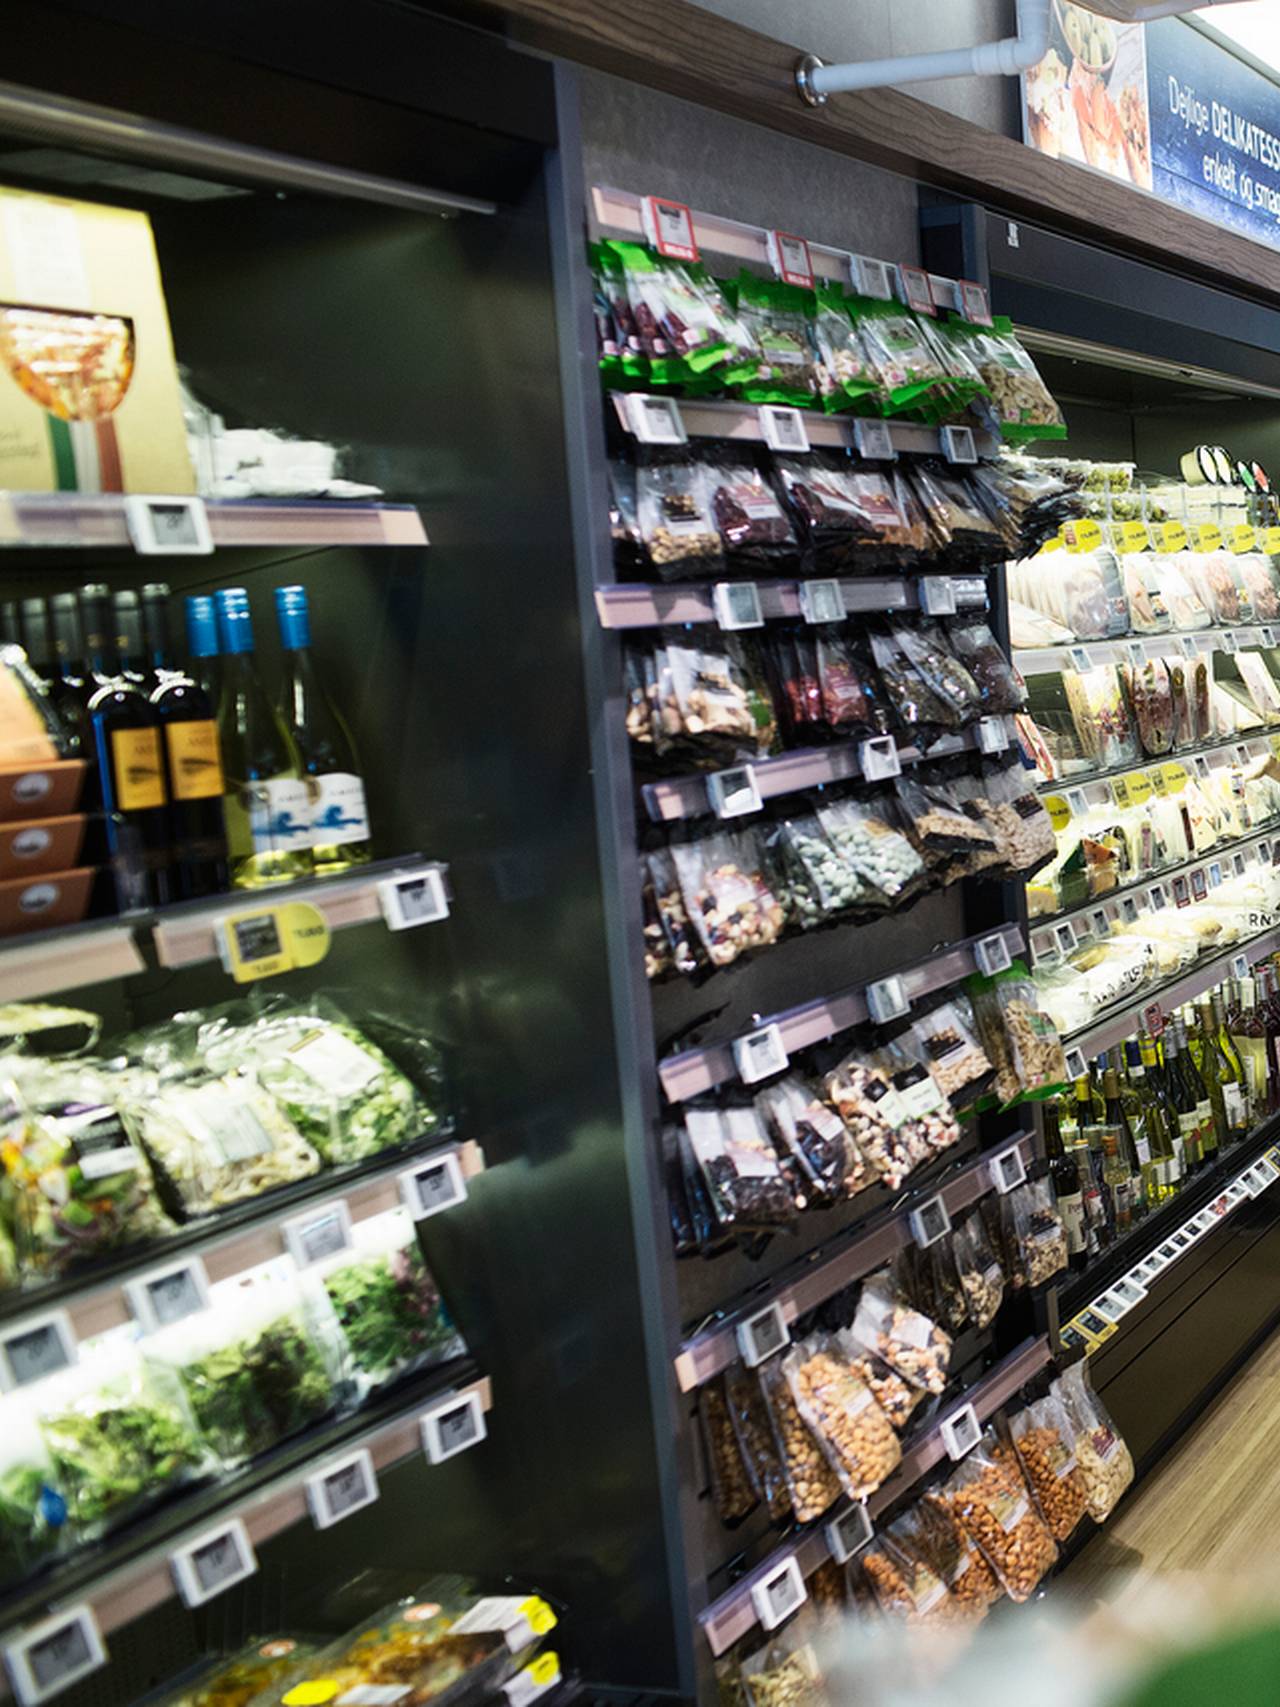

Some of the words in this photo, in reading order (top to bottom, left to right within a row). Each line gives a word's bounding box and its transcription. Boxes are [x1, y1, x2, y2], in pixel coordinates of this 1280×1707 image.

[1168, 75, 1209, 137] Dejlige
[1202, 150, 1237, 195] enkelt
[1240, 171, 1253, 210] og
